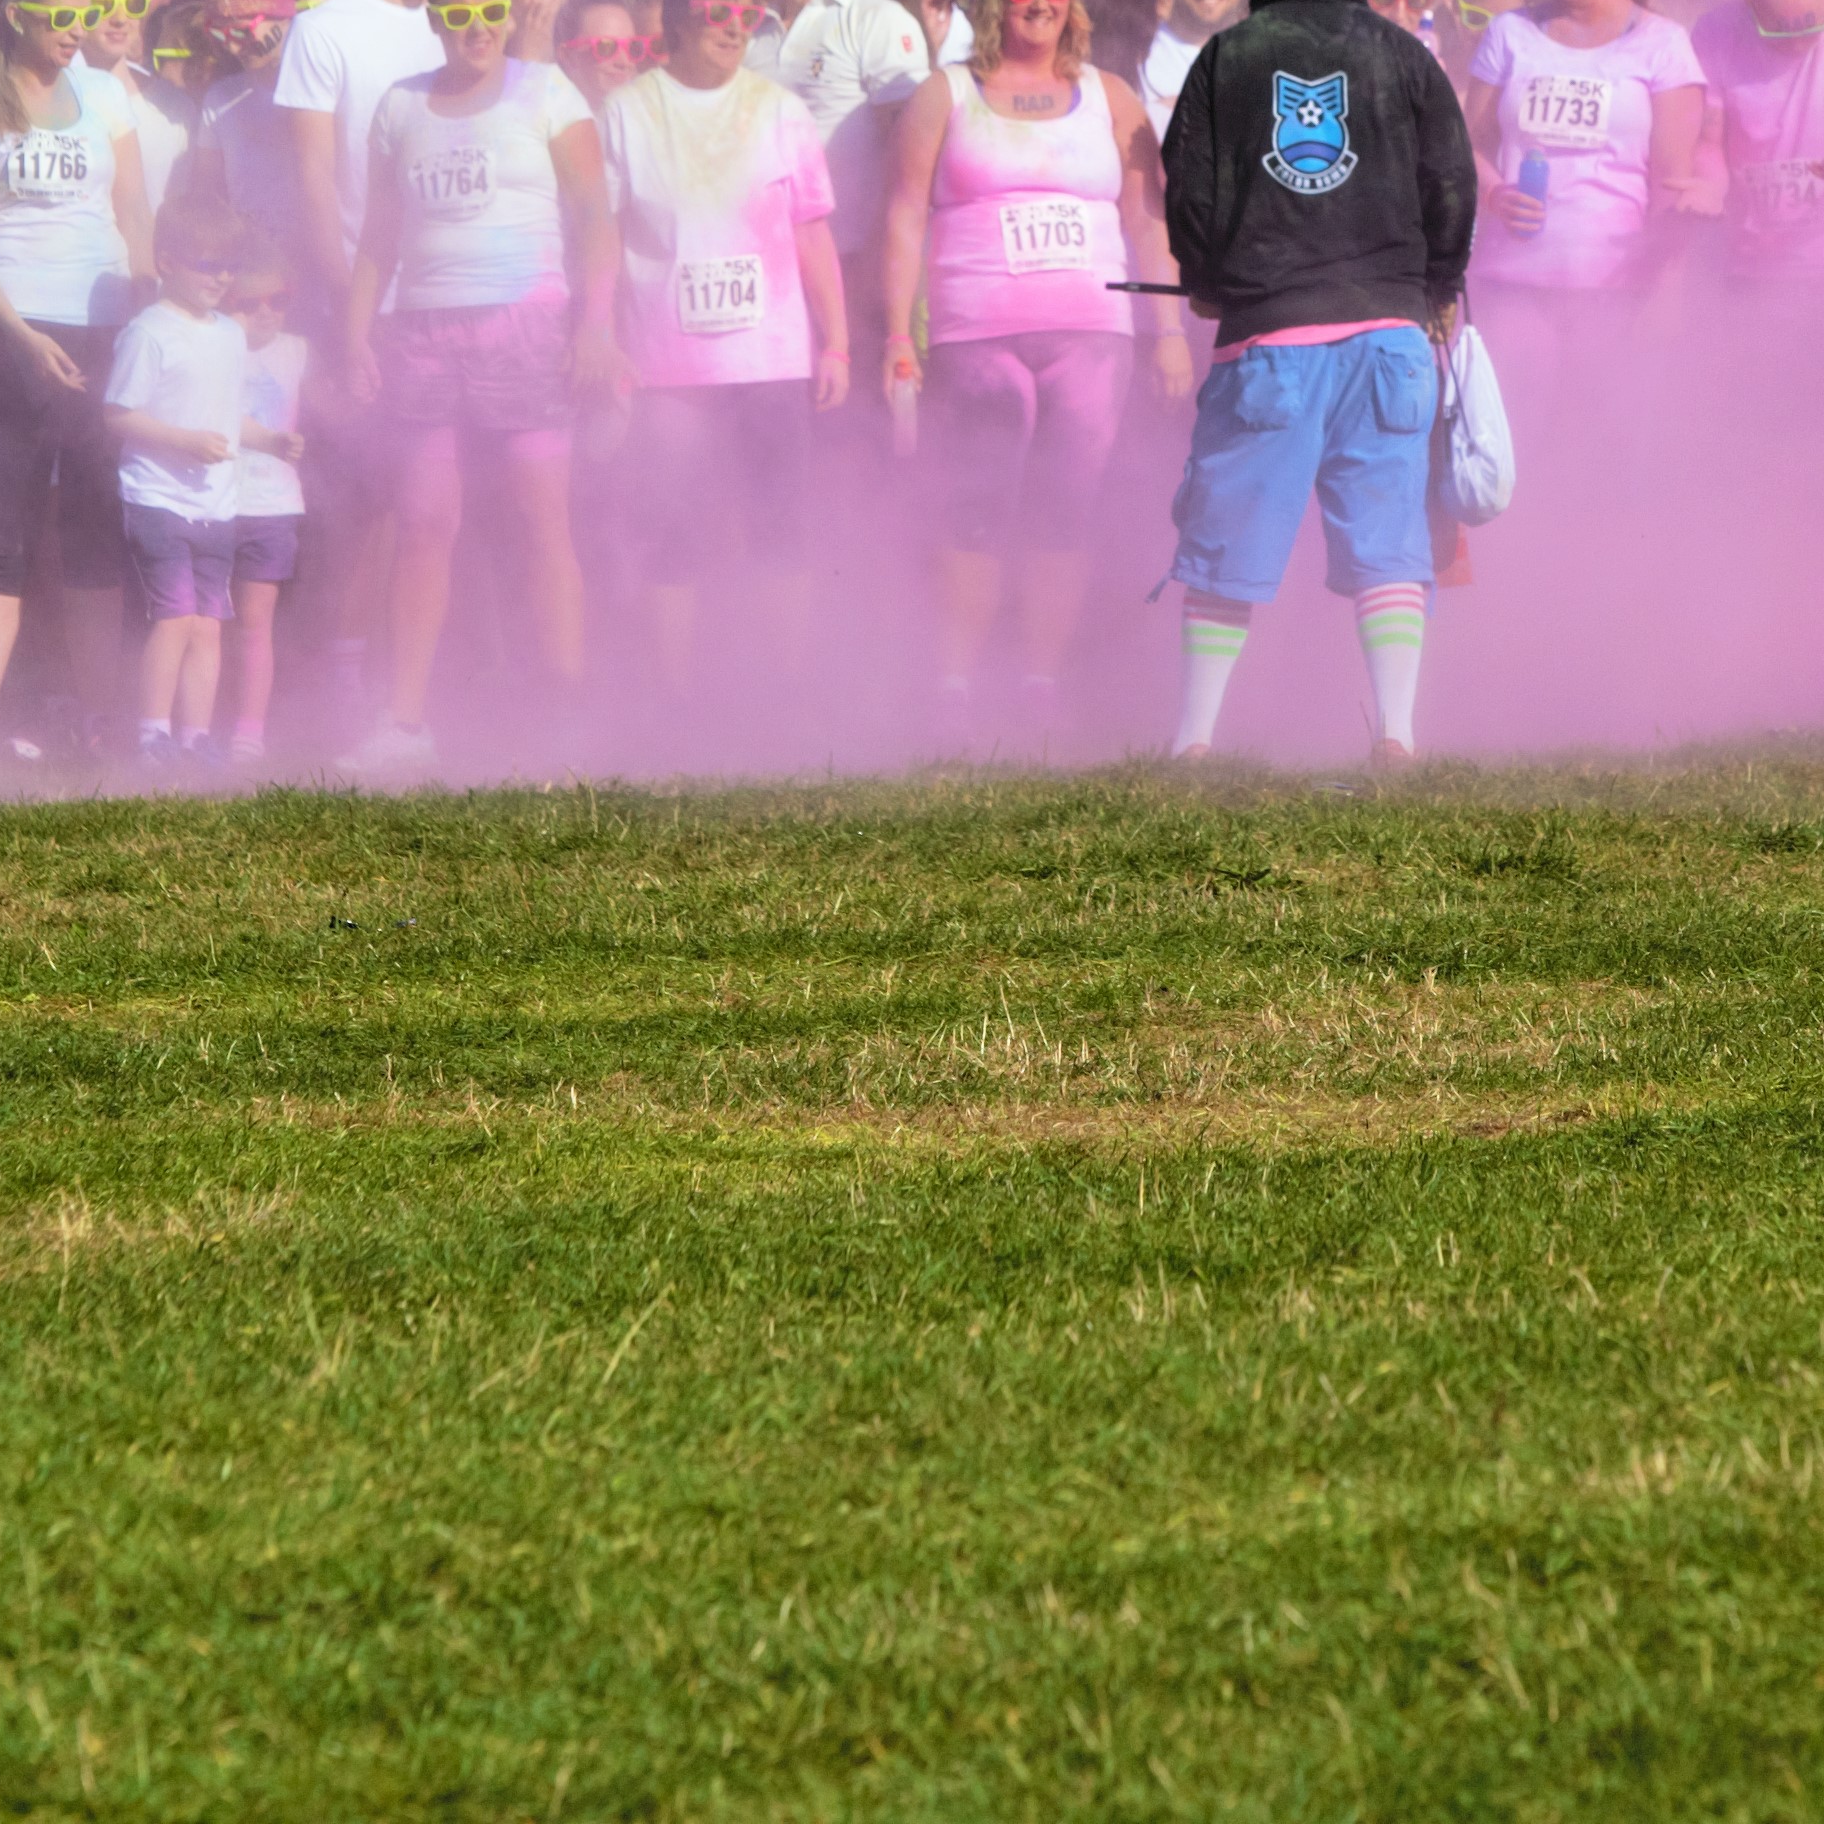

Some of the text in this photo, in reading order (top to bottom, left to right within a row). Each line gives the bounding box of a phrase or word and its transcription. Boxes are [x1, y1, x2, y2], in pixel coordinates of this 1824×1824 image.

[1012, 93, 1055, 113] RAD
[1527, 95, 1600, 127] 11733
[15, 153, 88, 181] 11766
[415, 164, 488, 202] 11764
[1011, 221, 1086, 251] 11703
[685, 278, 757, 312] 11704
